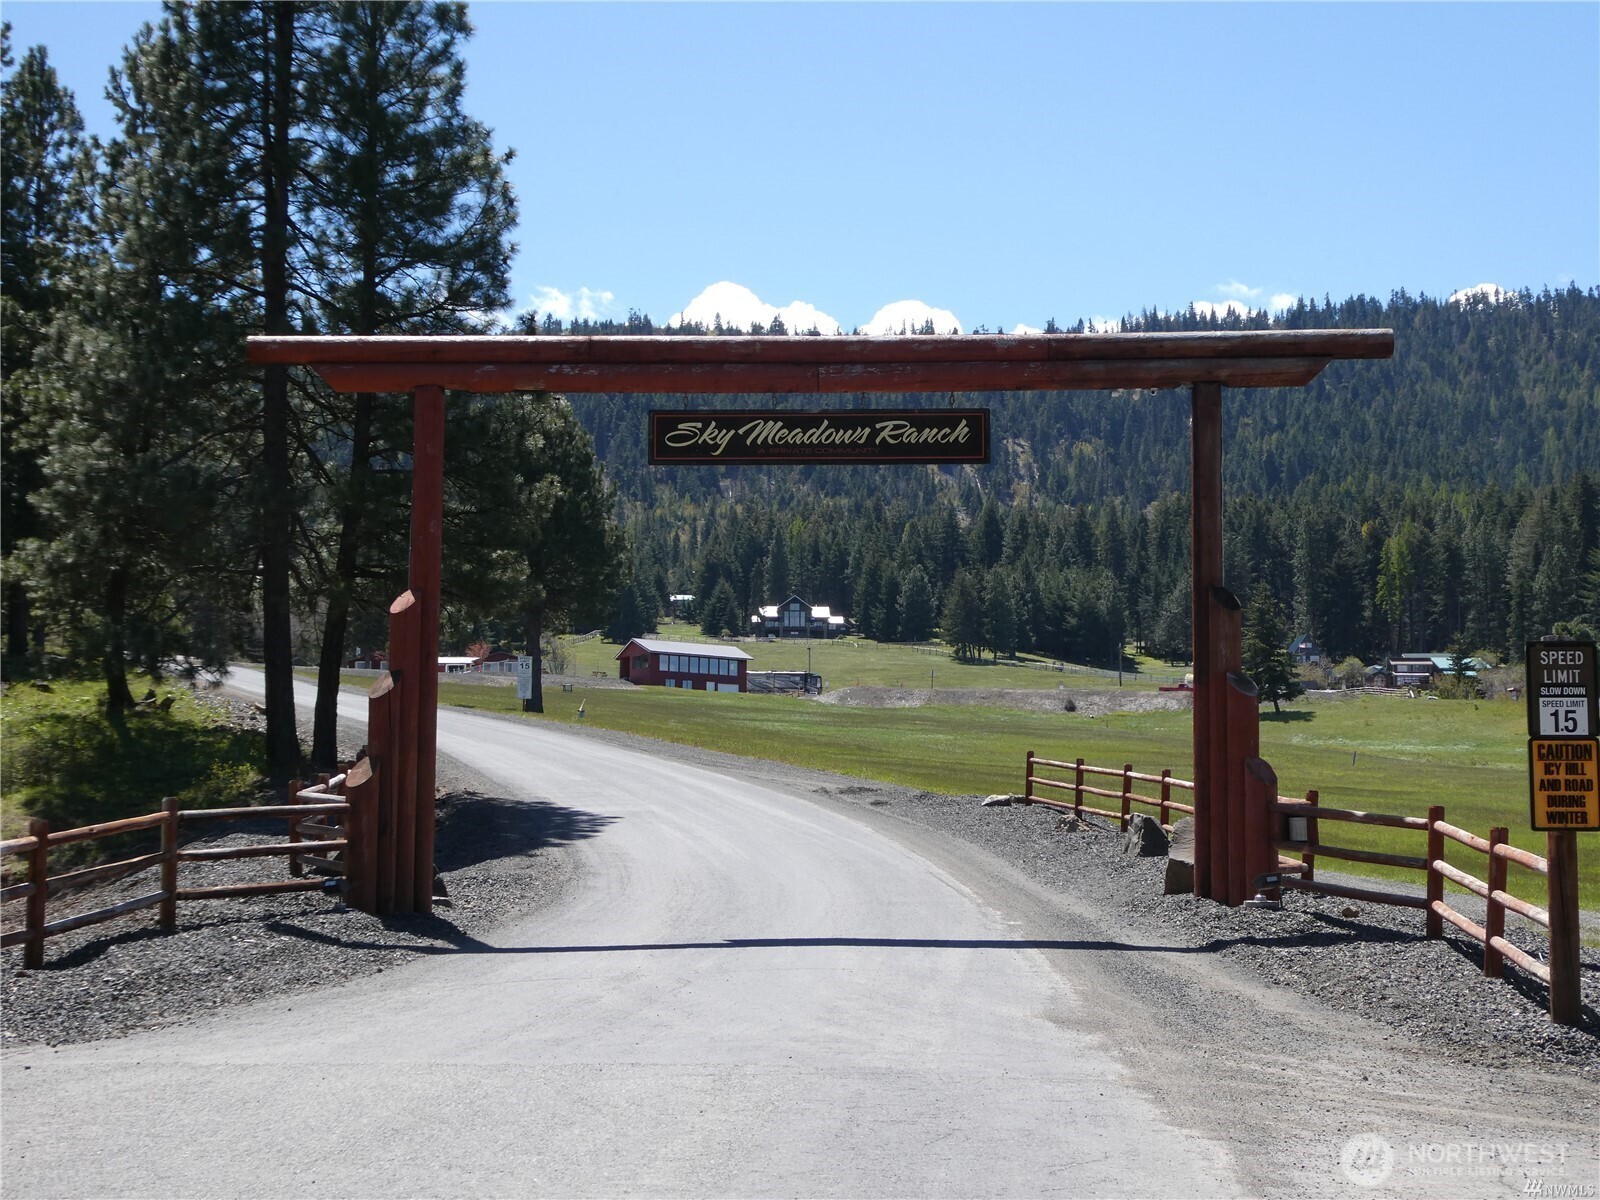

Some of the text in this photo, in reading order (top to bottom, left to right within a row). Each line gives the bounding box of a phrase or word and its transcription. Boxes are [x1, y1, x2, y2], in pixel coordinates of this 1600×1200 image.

[664, 418, 970, 456] Sky Meadows Ranch
[1540, 650, 1584, 665] SPEED
[1543, 669, 1581, 684] LIMIT
[1540, 686, 1586, 695] SLOW DOWN
[1542, 700, 1585, 708] SPEED LIMIT
[1537, 743, 1592, 760] CAUTION
[1544, 763, 1587, 776] ICY HILL
[1539, 779, 1593, 792] AND ROAD
[1547, 795, 1586, 809] DURING
[1546, 811, 1588, 825] WINTER
